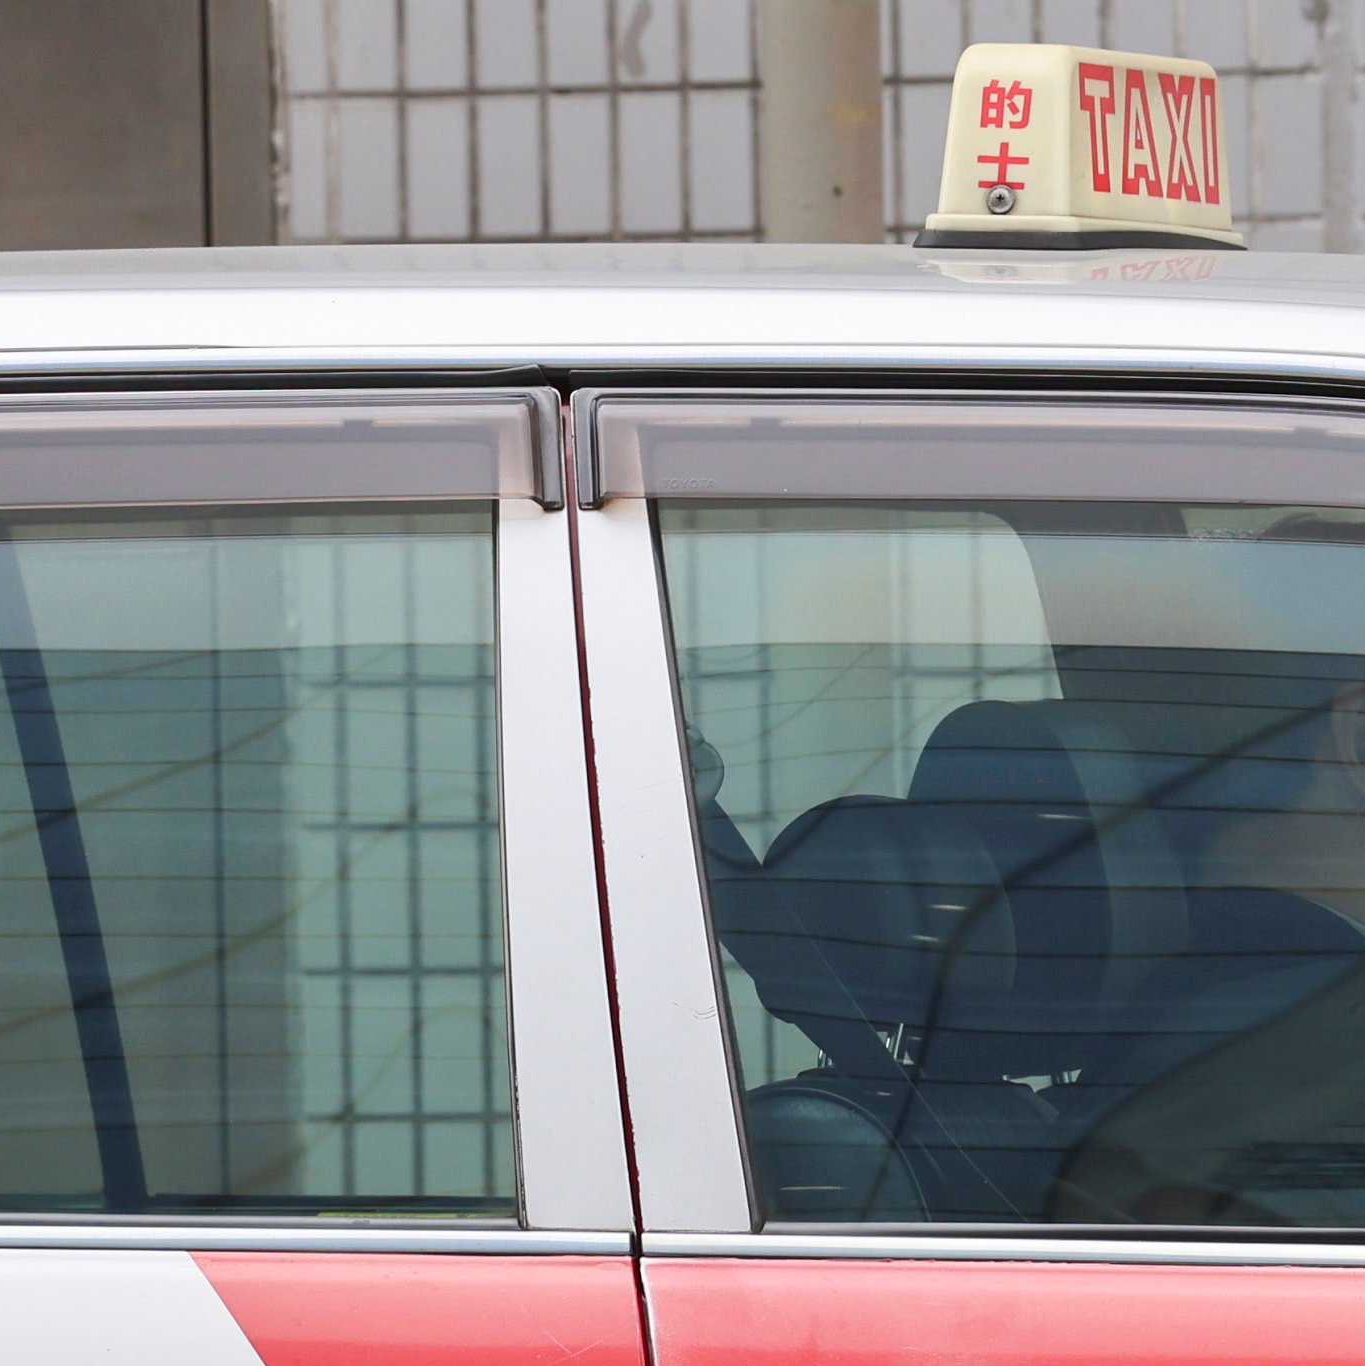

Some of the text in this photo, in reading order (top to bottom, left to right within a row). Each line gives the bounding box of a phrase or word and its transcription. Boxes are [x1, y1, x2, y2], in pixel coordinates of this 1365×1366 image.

[977, 79, 1033, 191] 的士
[1078, 61, 1220, 205] TAXI
[662, 478, 716, 489] TOYOTA
